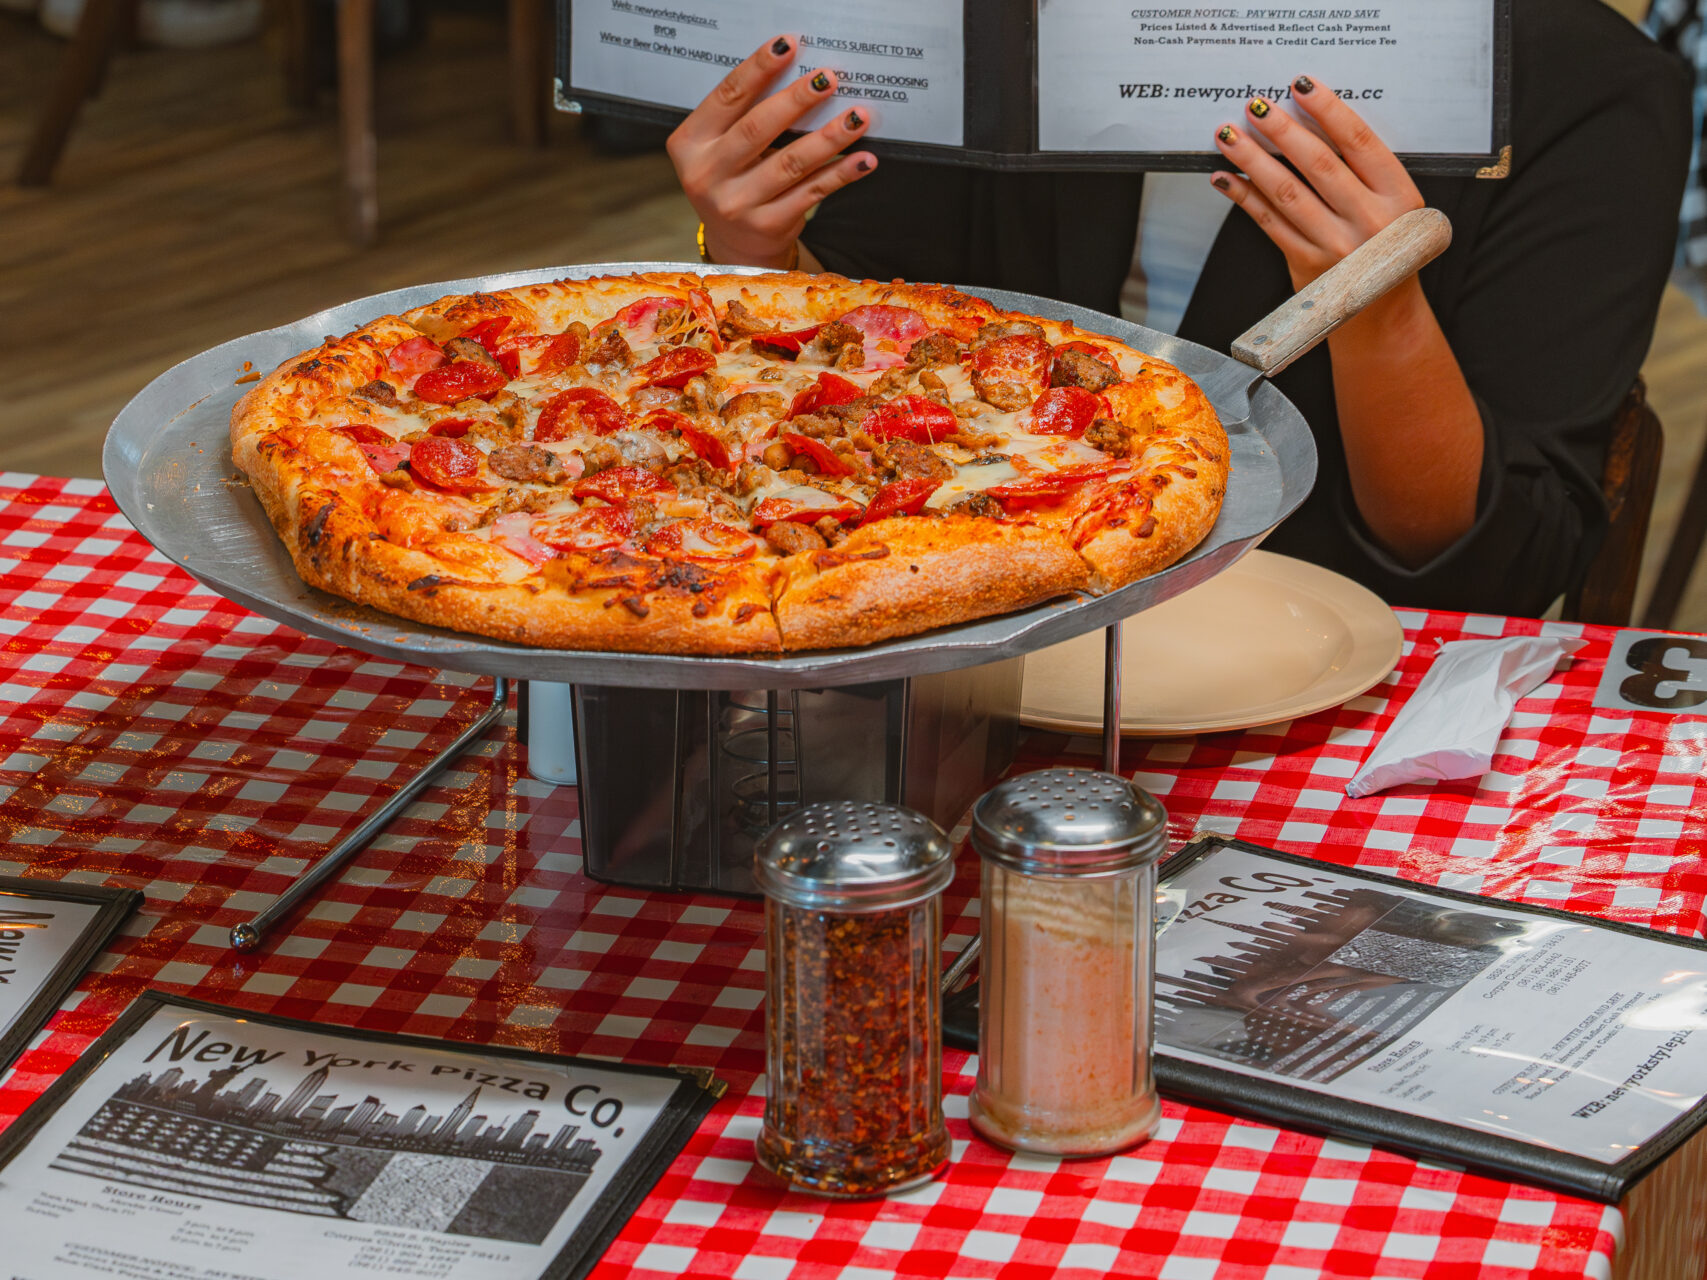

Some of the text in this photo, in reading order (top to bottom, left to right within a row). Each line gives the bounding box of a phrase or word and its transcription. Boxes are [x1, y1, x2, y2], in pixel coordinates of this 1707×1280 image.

[1131, 9, 1381, 18] CUSTOMER NOTICE: PAY WITH CASH AND SAVE
[654, 25, 676, 37] BYOB
[1140, 23, 1390, 34] Prices Listed & Advertised Reflect Cash Payment
[600, 31, 621, 43] Wine
[633, 38, 650, 49] Beer
[653, 42, 671, 55] Only
[674, 46, 686, 56] NO
[689, 49, 712, 61] HARD
[800, 35, 923, 56] ALL PRICES SUBJECT TO TAX
[1134, 37, 1397, 47] Non-Cash Payments Have Credit Card Service Fee
[834, 71, 928, 88] YOU FOR CHOOSING
[837, 86, 891, 99] YORK PIZZA
[1119, 84, 1384, 103] WEB: newyorkstylza.cc
[1219, 872, 1336, 893] Co.
[143, 1025, 625, 1138] New York Pizza Co.
[1571, 1100, 1611, 1119] WEB:
